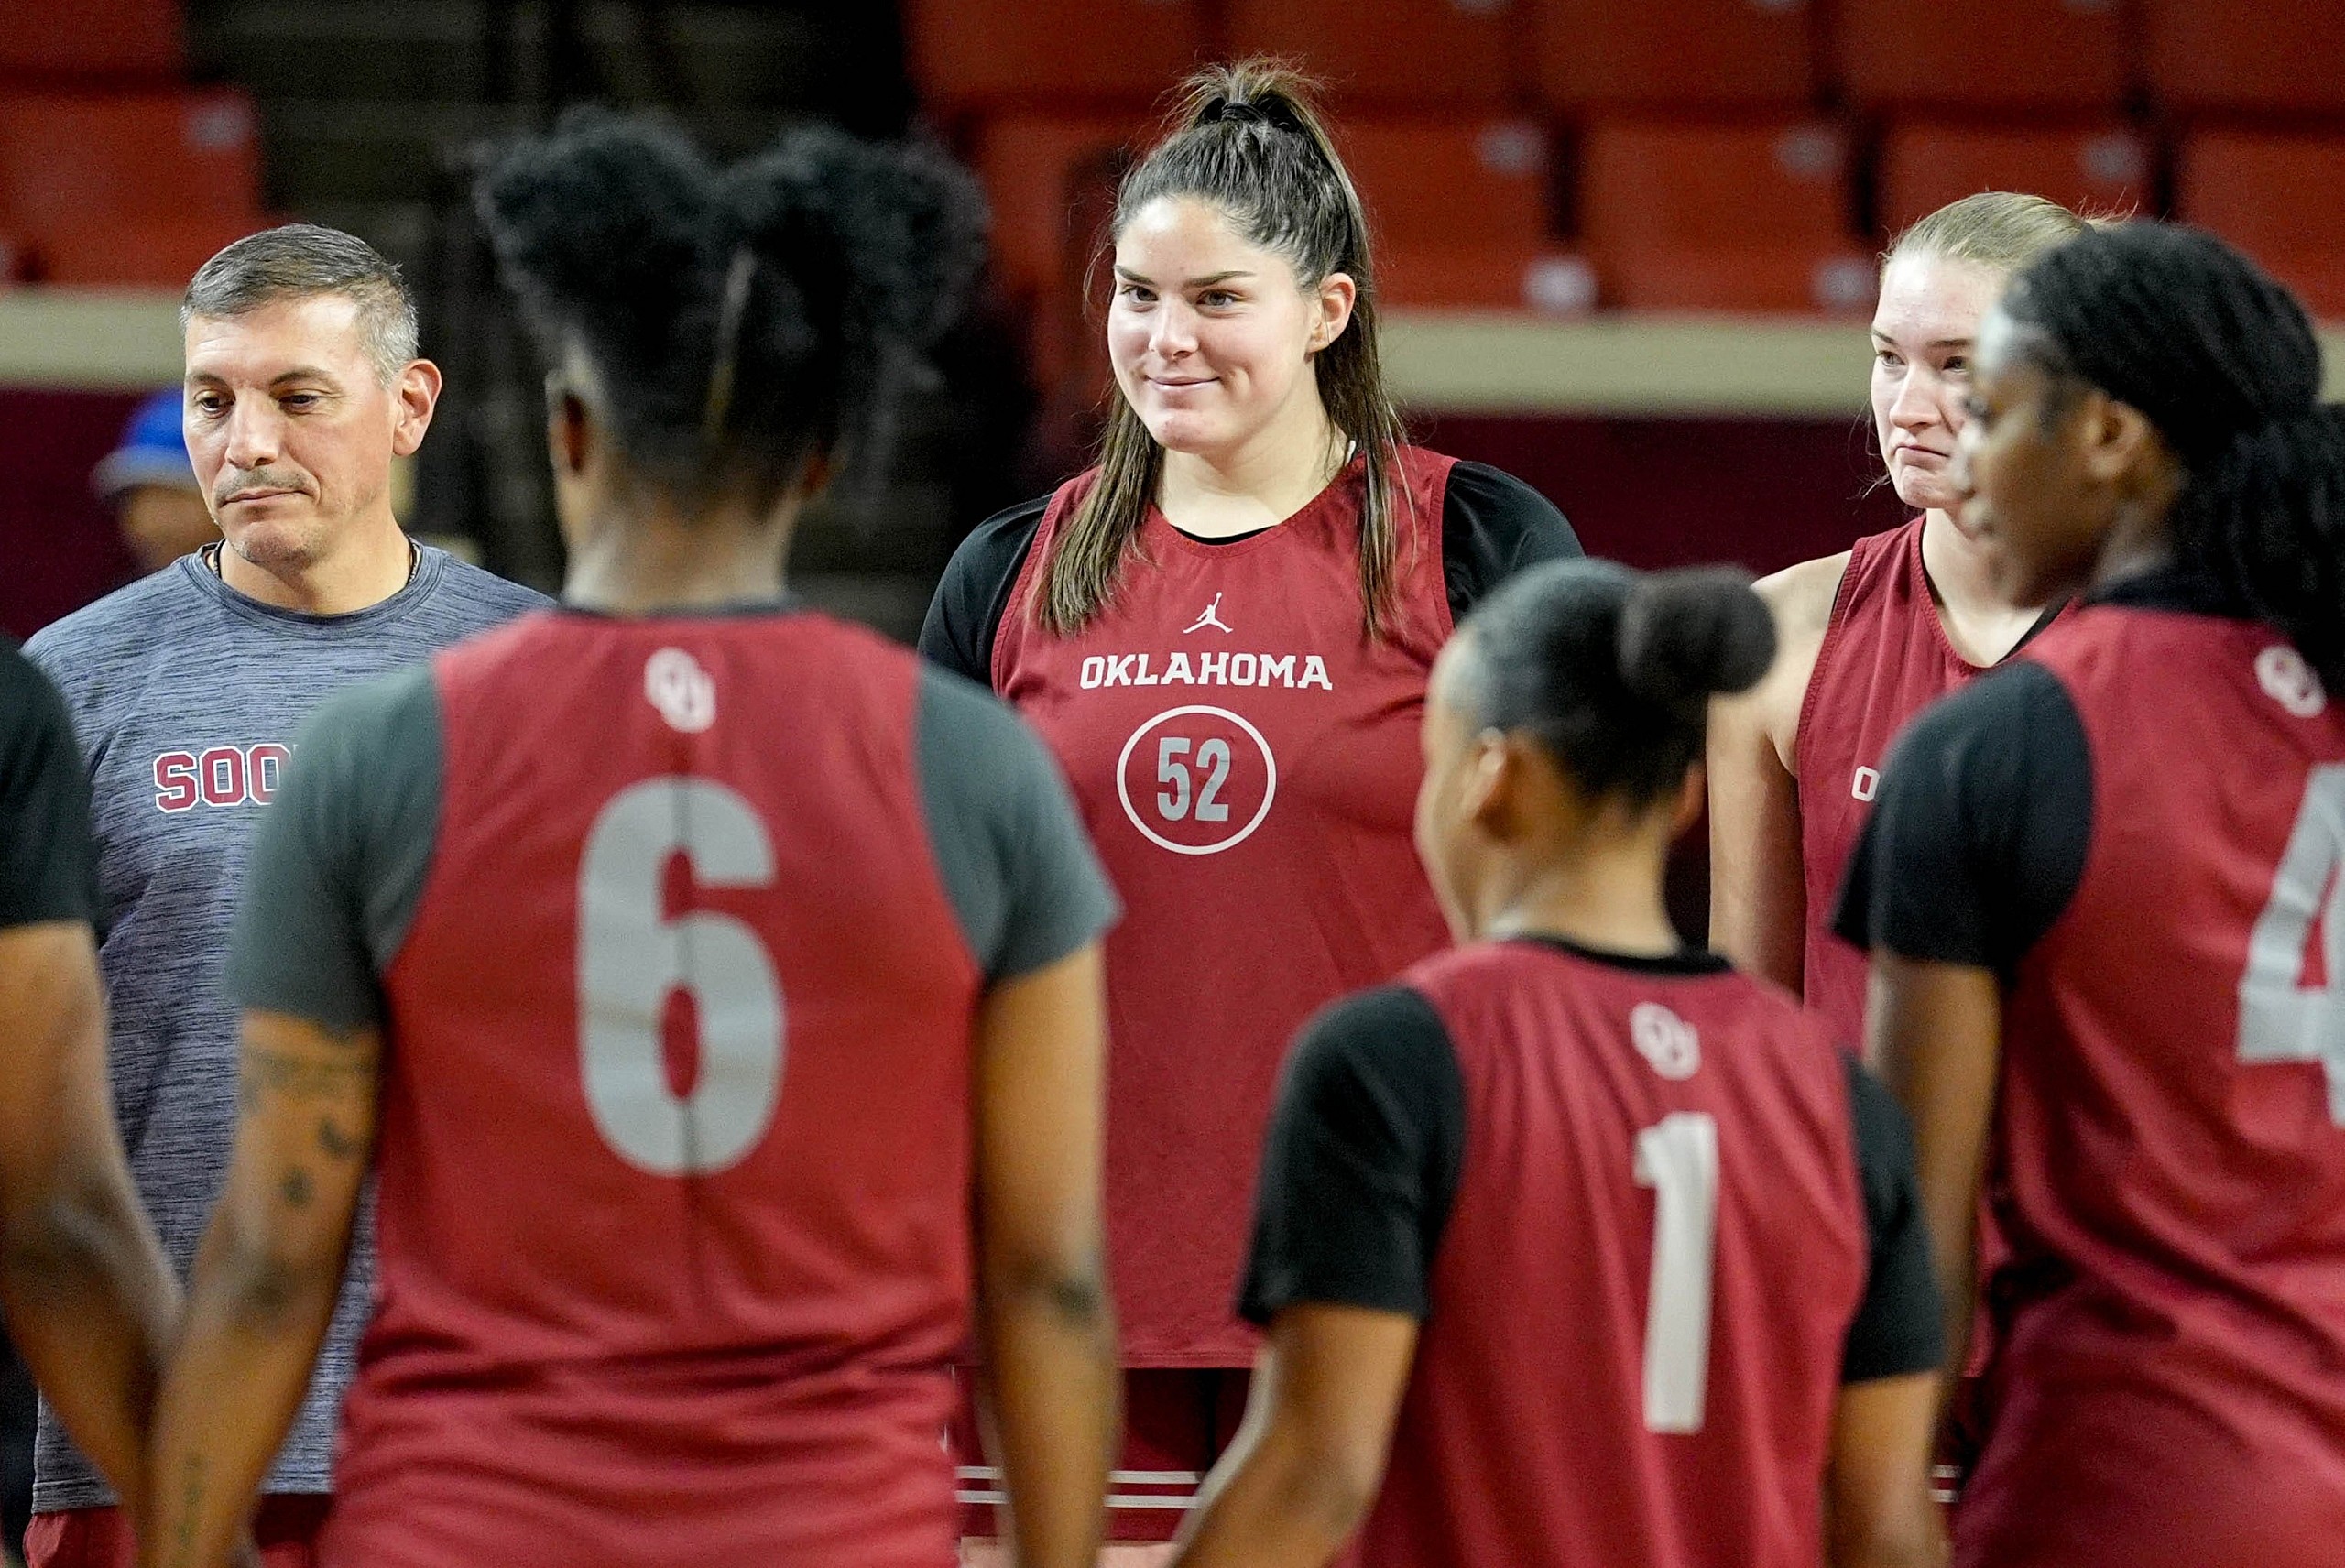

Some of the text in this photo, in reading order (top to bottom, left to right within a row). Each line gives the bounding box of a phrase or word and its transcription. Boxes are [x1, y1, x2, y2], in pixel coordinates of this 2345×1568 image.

[1080, 652, 1333, 690] OKLAHOMA
[153, 743, 298, 813] SOO
[1157, 736, 1231, 822] 52
[577, 775, 785, 1177] 6
[2235, 763, 2345, 1128] 4
[1633, 1110, 1718, 1435] 1
